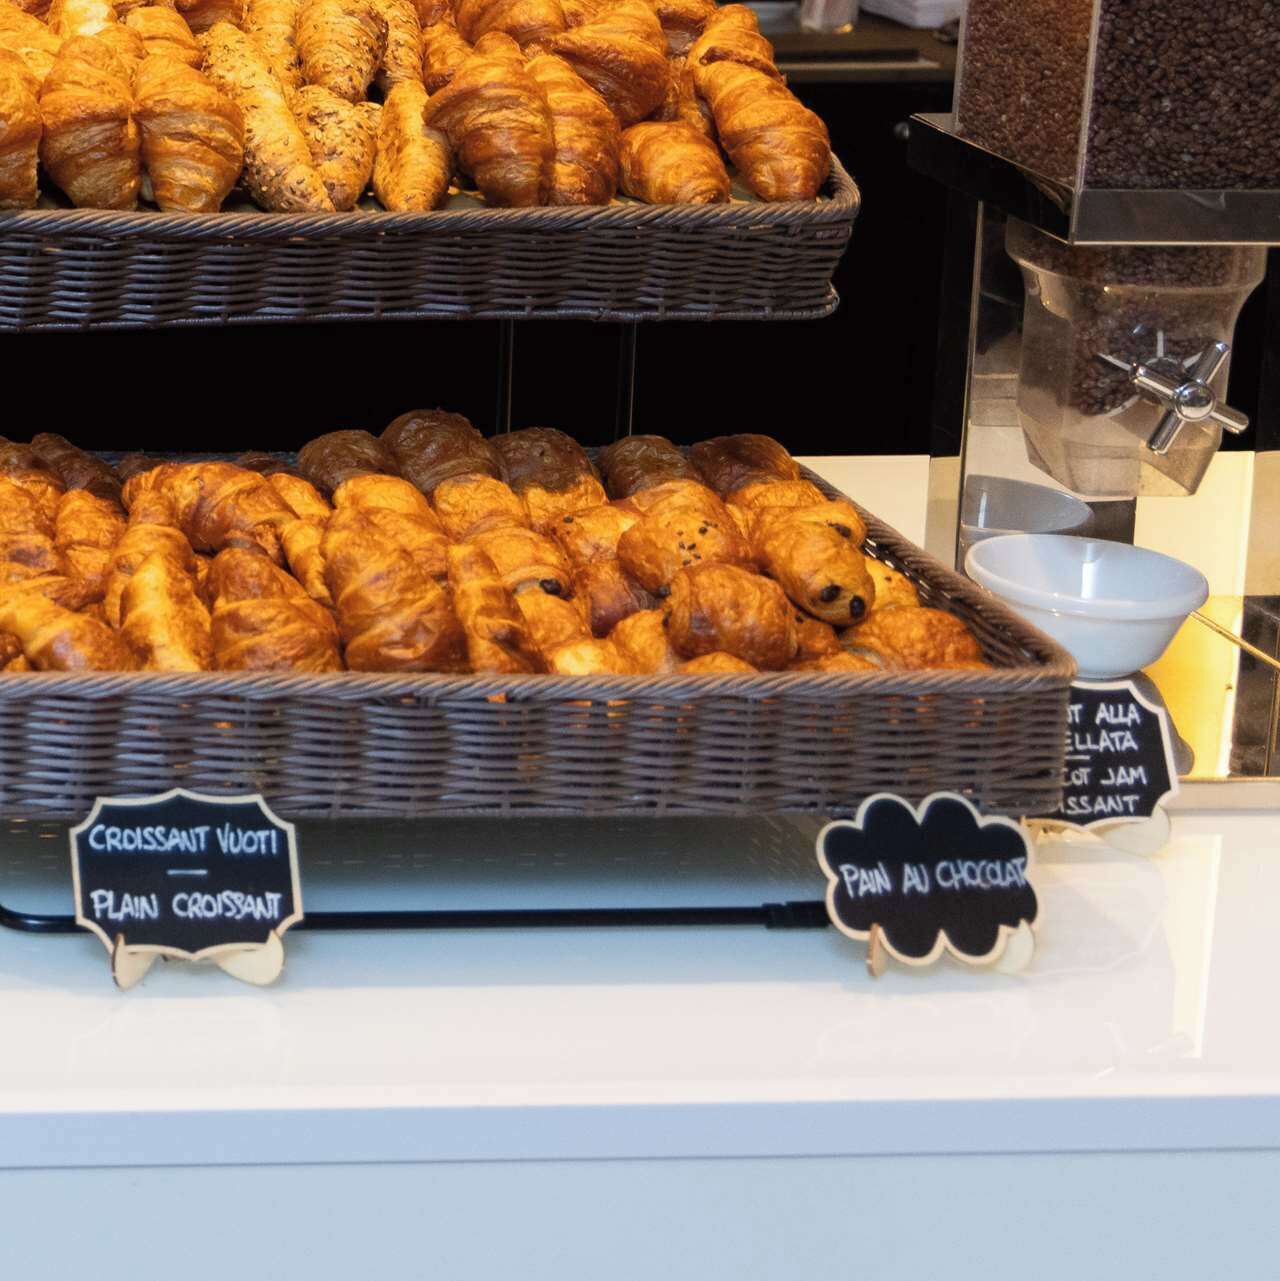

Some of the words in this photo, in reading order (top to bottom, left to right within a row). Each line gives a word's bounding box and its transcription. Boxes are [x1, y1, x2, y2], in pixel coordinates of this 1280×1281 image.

[1095, 701, 1142, 727] ALLA
[1064, 730, 1139, 753] ELLATA
[1100, 765, 1147, 786] JAM
[1058, 794, 1141, 815] ISSANT
[88, 823, 211, 853] CROISSANT
[216, 822, 279, 855] VUOTI
[839, 861, 892, 899] PAIN
[901, 863, 930, 896] AU
[90, 889, 159, 921] PLAIN
[172, 891, 283, 922] CROISSANT
